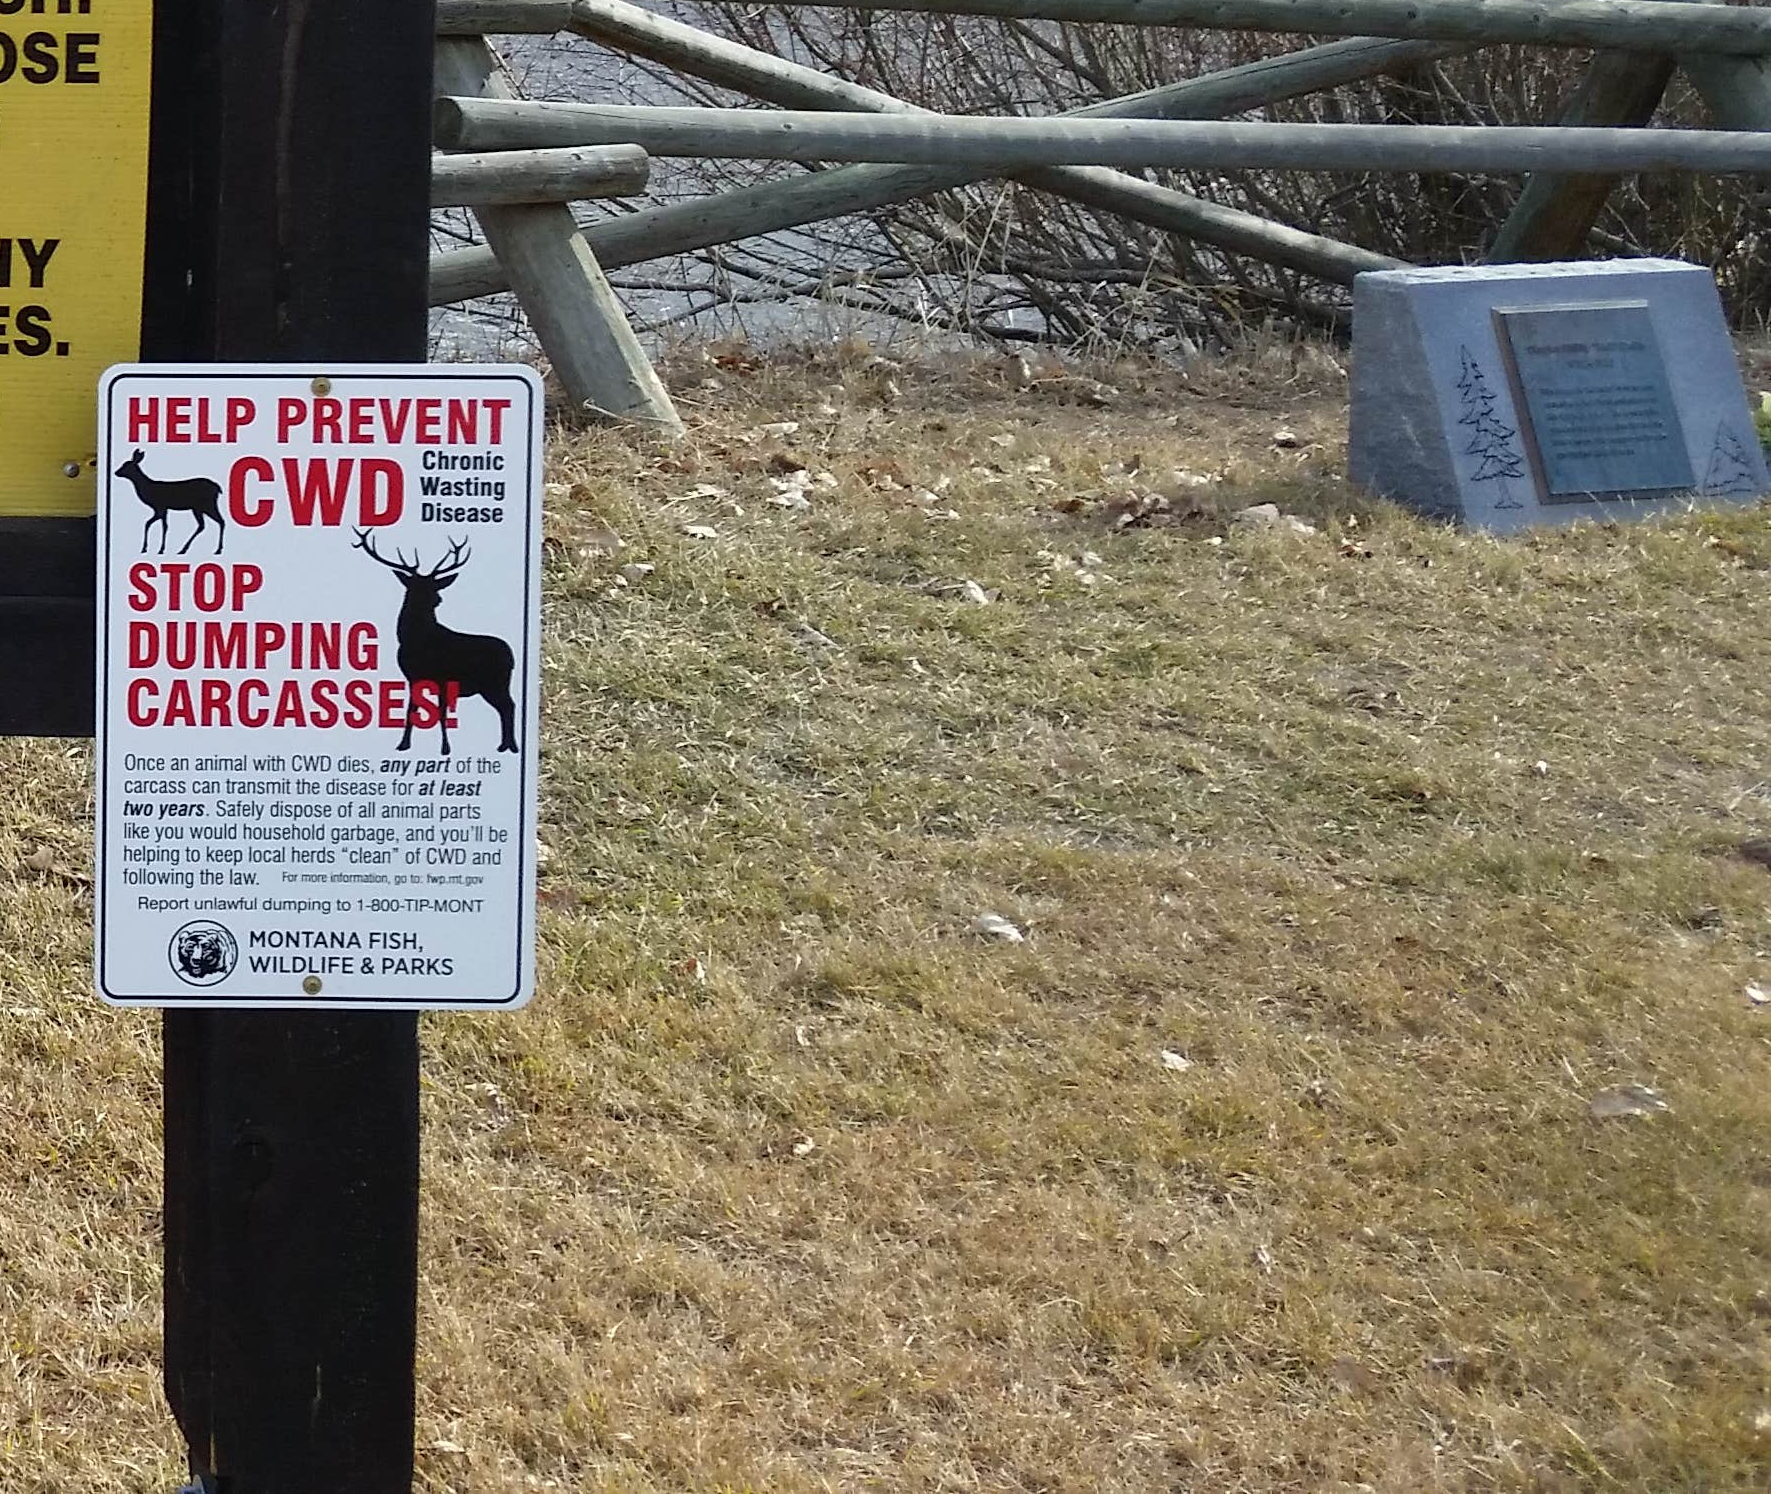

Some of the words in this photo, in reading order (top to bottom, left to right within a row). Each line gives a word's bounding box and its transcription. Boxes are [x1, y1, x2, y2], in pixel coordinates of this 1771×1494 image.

[128, 397, 256, 444] HELP
[277, 397, 512, 445] PREVENT
[422, 450, 505, 471] Chronic
[227, 456, 405, 528] CWD
[419, 476, 506, 502] Wasting
[421, 502, 503, 523] Disease
[128, 562, 263, 613] STOP
[128, 621, 379, 671] DUMPING
[124, 753, 165, 771] Once
[170, 757, 189, 771] an
[195, 754, 247, 772] animal
[252, 754, 286, 772] with
[291, 754, 332, 772] CWD
[337, 755, 375, 774] dies,
[379, 759, 412, 777] any
[414, 757, 452, 777] part
[456, 756, 472, 774] of
[476, 757, 501, 774] the
[138, 896, 190, 913] Report
[194, 896, 258, 911] unlawful
[262, 897, 331, 915] dumping
[336, 899, 352, 912] to
[357, 898, 484, 913] 1-800-TIP-MONT
[249, 930, 362, 949] MONTANA
[369, 932, 423, 953] FISH,
[249, 956, 354, 976] WILDLIFE
[360, 957, 375, 975] &
[382, 957, 454, 976] PARKS
